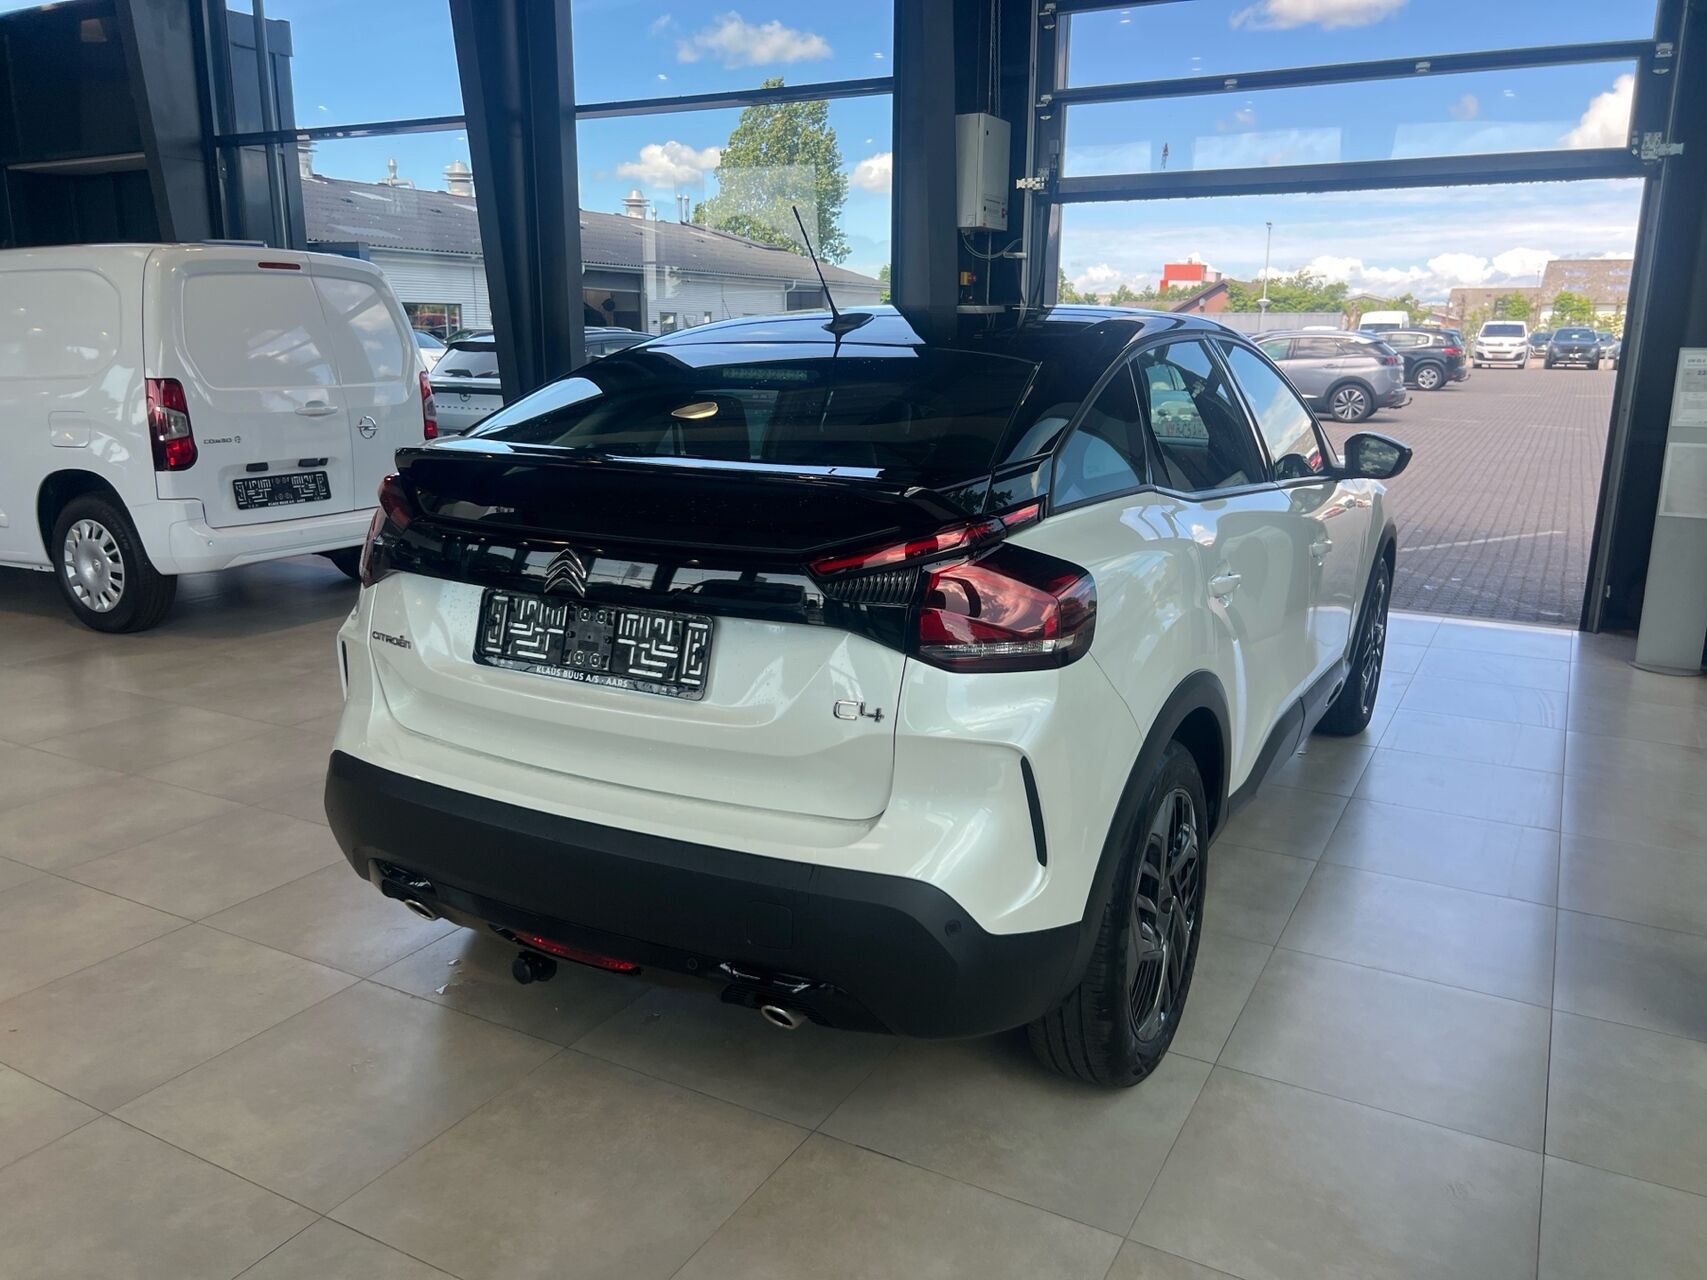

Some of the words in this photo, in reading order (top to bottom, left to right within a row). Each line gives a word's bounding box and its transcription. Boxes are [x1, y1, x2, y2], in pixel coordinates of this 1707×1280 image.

[536, 664, 561, 677] KLAUS
[562, 669, 584, 681] BUUS
[585, 674, 600, 684] A/S
[605, 677, 628, 688] AARS
[833, 699, 885, 723] C4
